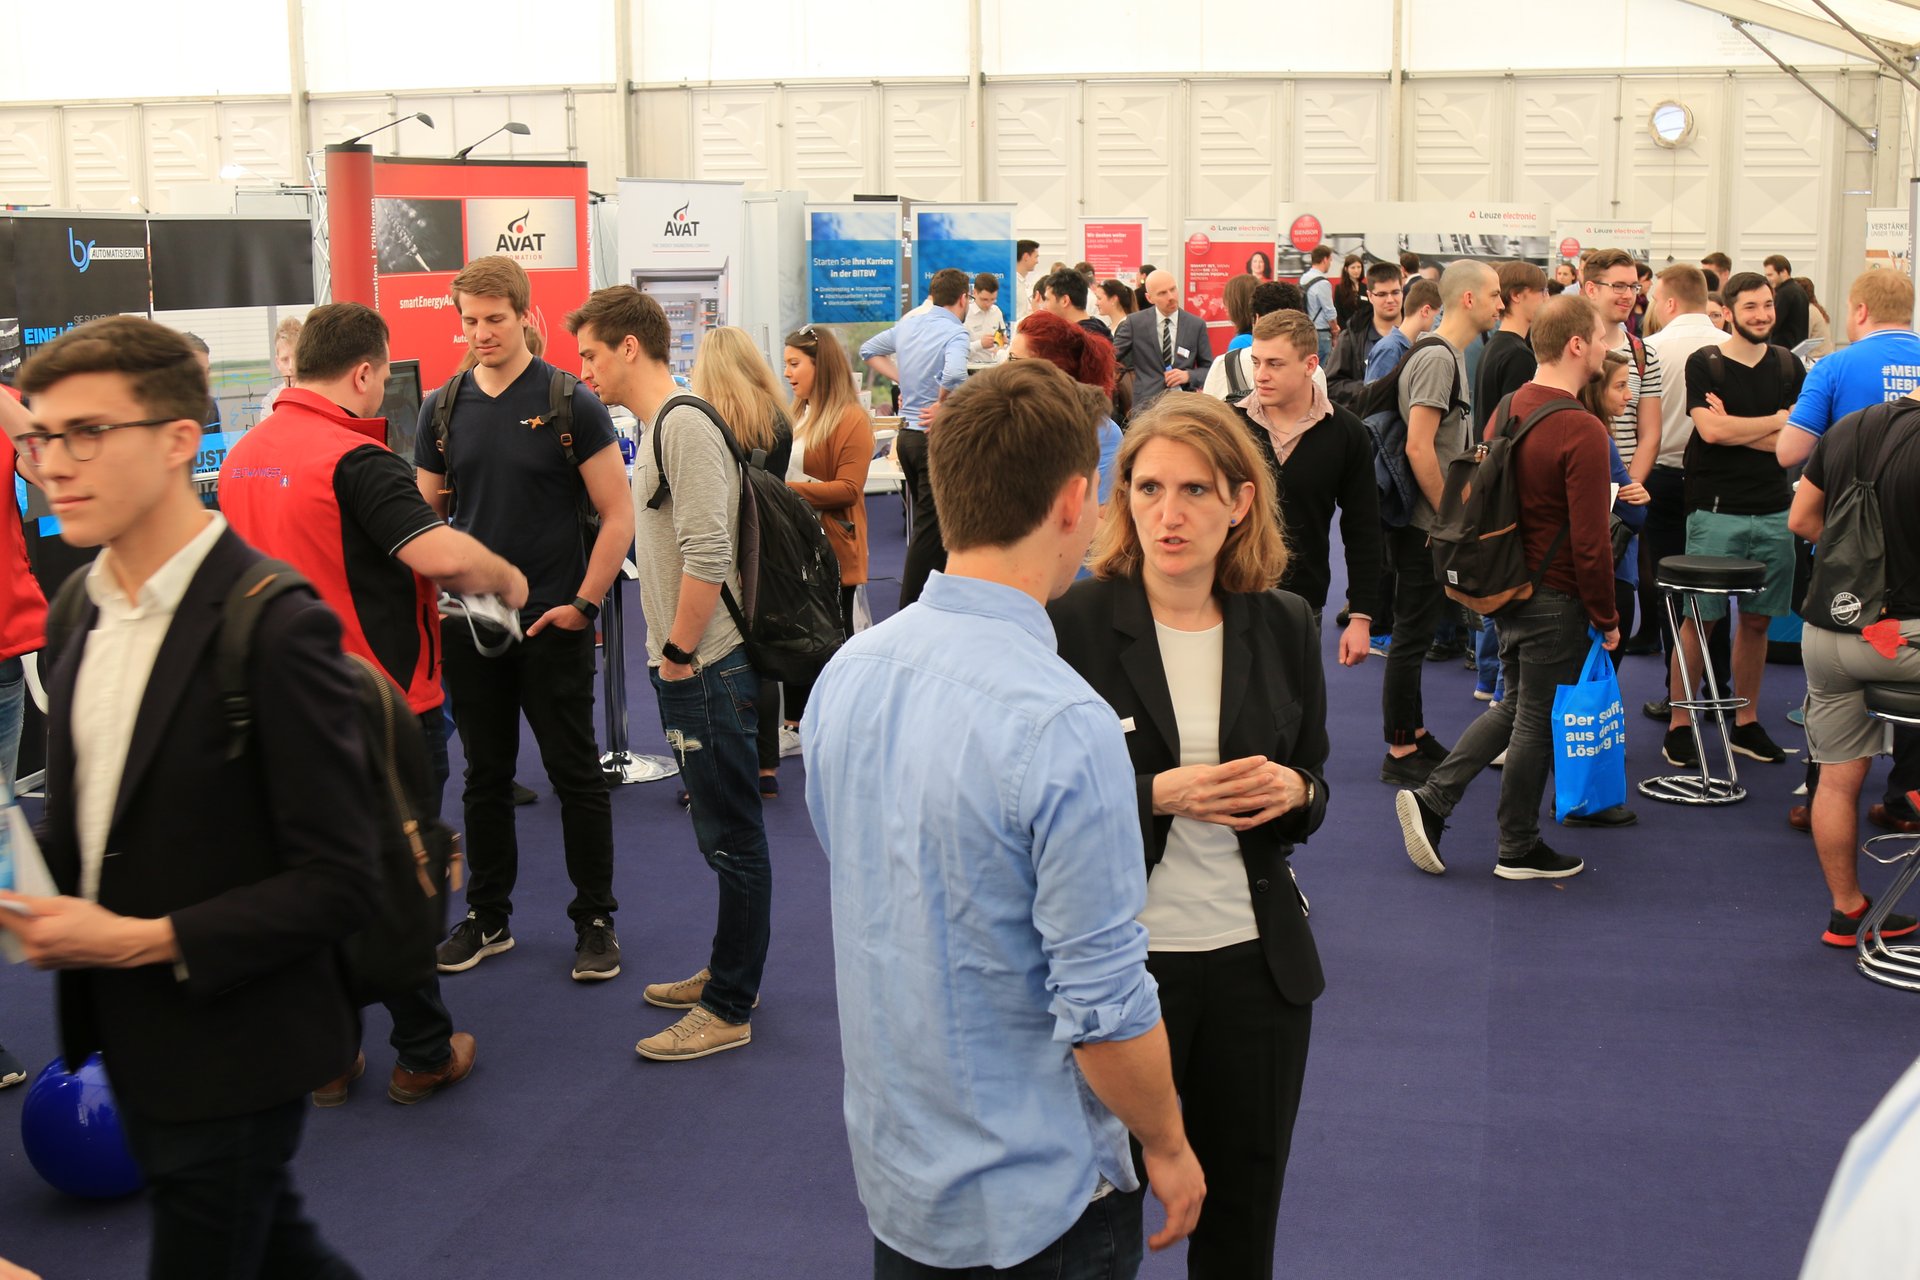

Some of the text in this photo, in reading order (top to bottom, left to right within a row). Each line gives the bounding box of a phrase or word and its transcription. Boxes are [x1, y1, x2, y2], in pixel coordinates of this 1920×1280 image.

[1479, 211, 1537, 220] Leuze electronic
[664, 220, 700, 236] AVAT
[1871, 222, 1908, 230] VERSTÄRKE
[496, 233, 546, 252] AVAT
[91, 248, 144, 258] AUTOMATISIERUNG
[813, 257, 893, 266] Starten Sie Ihre Karriere
[830, 269, 877, 277] in der BITBW
[1564, 713, 1595, 727] Der
[1565, 731, 1595, 742] aus
[1566, 736, 1611, 758] Lösug
